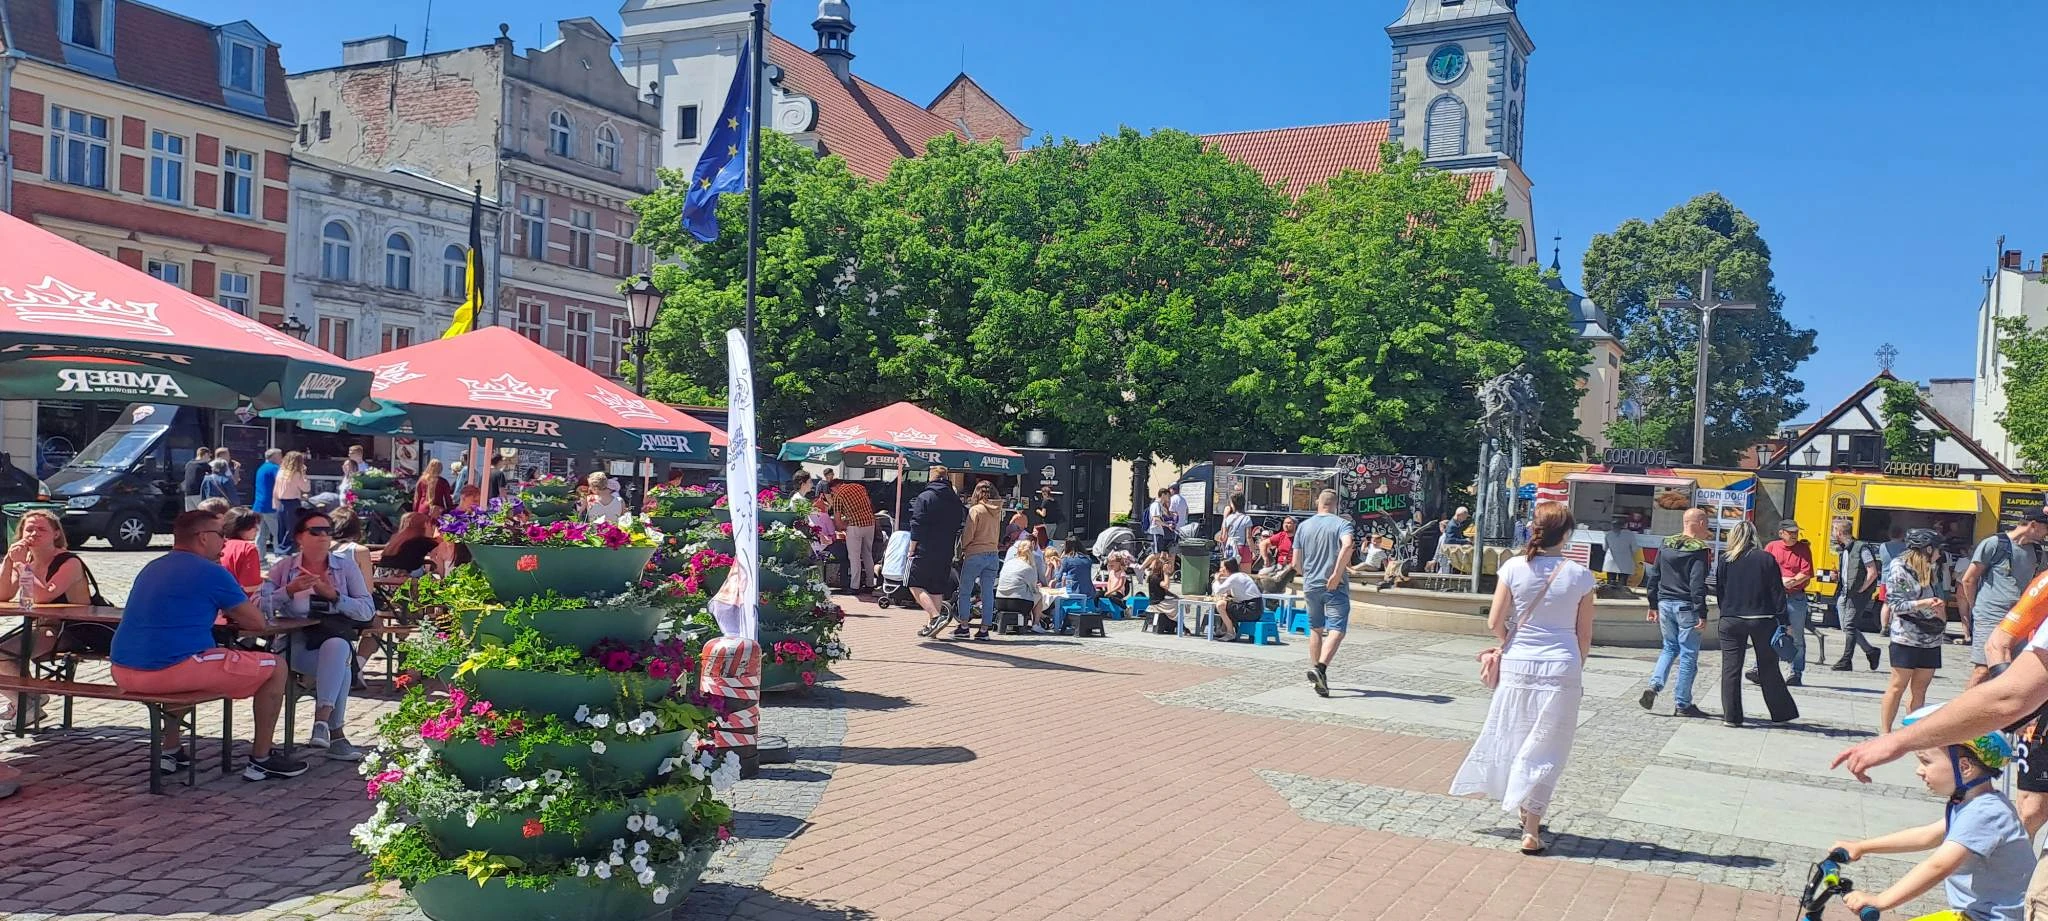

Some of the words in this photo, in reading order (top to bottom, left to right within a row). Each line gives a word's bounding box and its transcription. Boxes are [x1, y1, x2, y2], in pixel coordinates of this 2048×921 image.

[294, 372, 346, 400] AMBER
[458, 414, 562, 437] AMBER
[638, 433, 693, 453] AMBER
[980, 456, 1010, 470] AMBER
[1604, 448, 1636, 464] CORN
[1884, 461, 1933, 477] ZAPIEKANE
[1697, 490, 1721, 499] CORN
